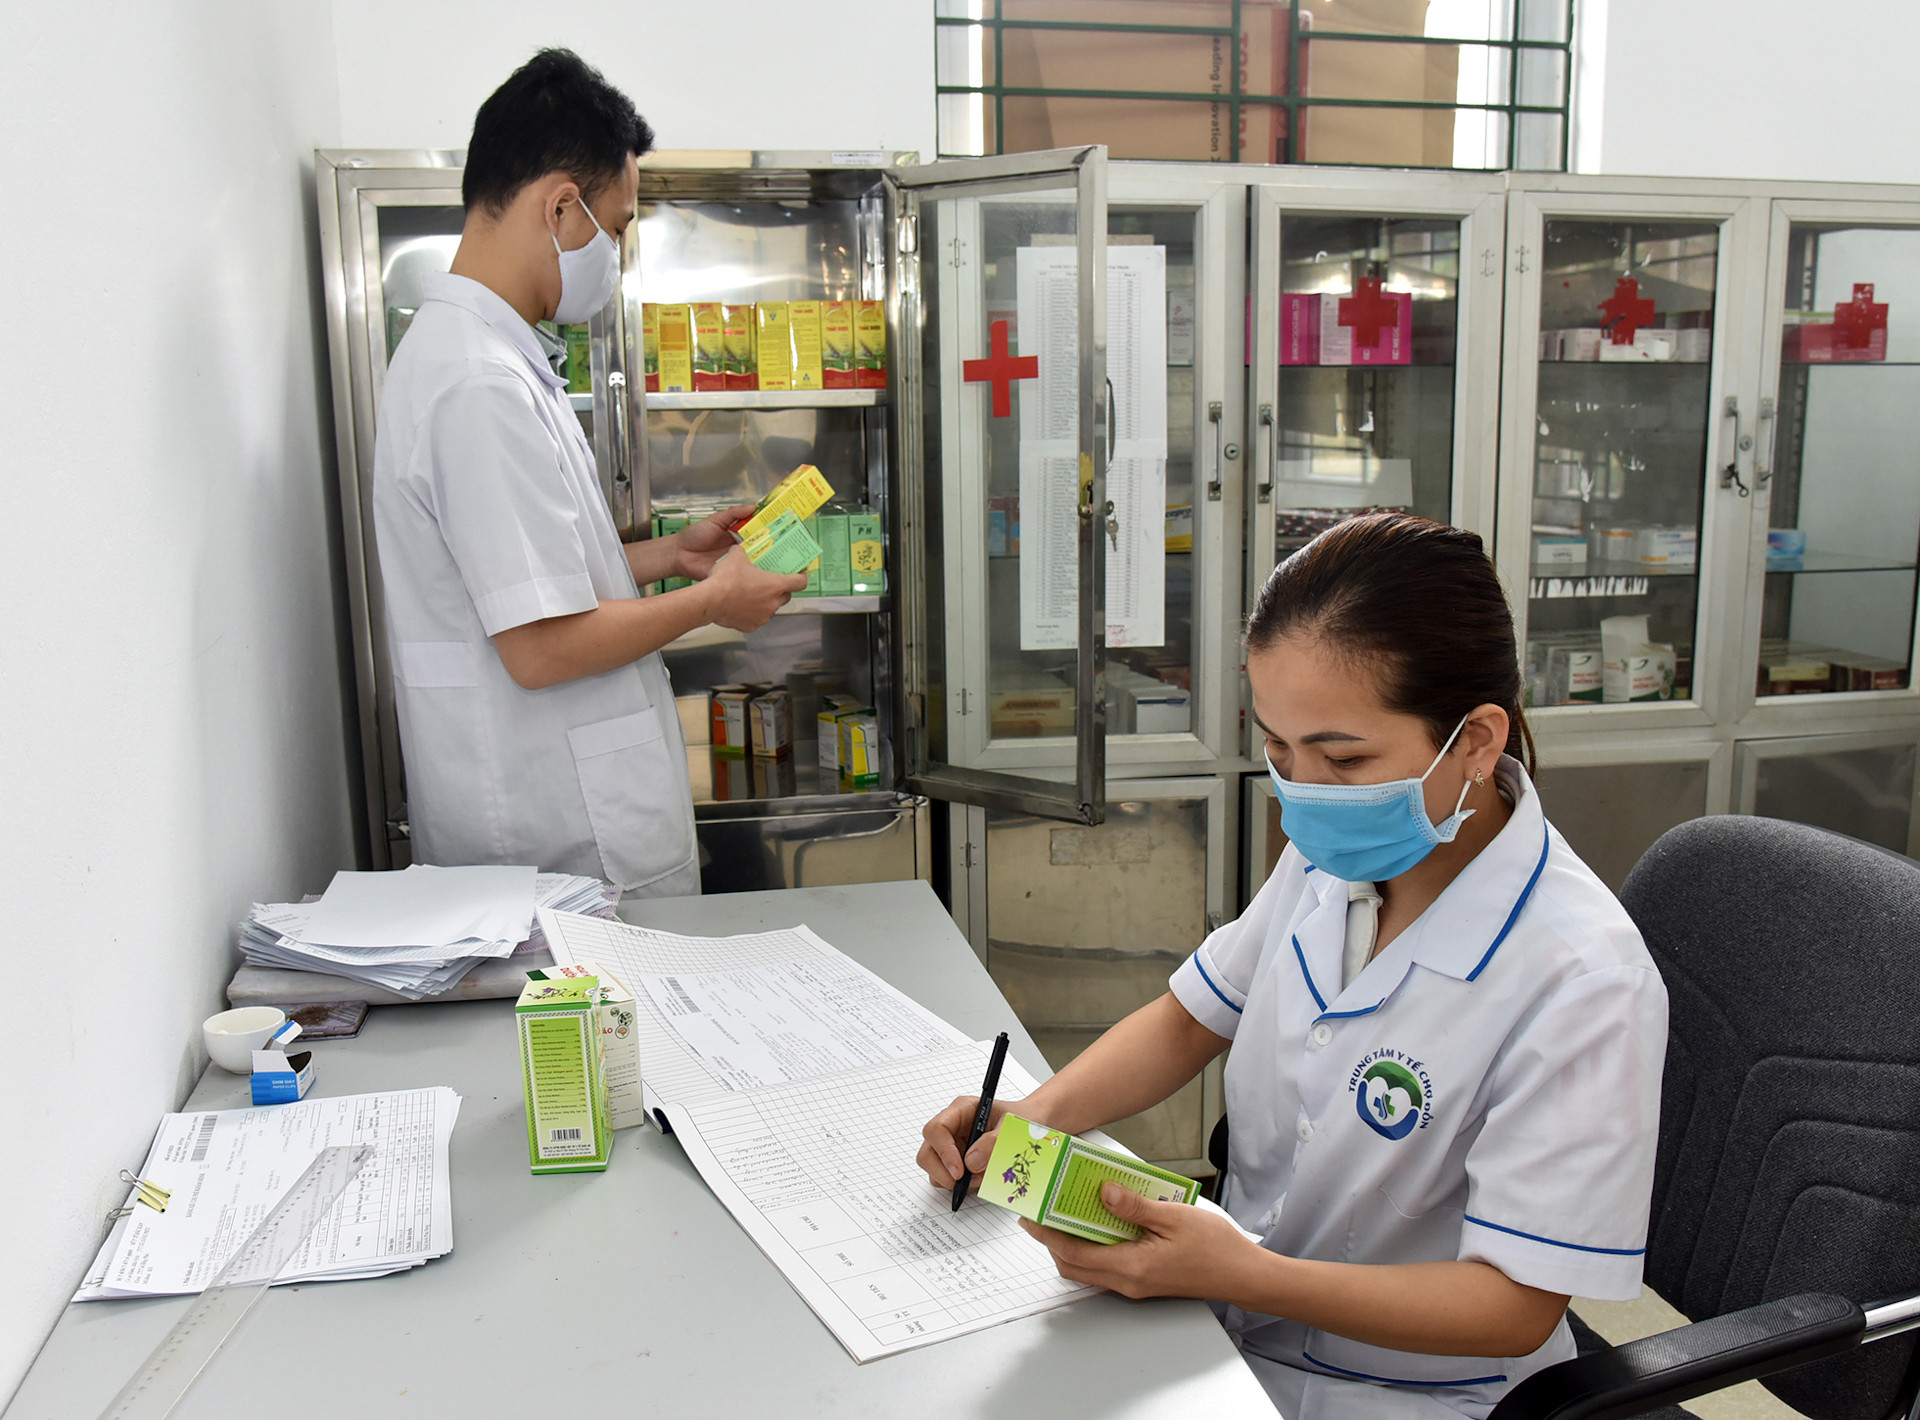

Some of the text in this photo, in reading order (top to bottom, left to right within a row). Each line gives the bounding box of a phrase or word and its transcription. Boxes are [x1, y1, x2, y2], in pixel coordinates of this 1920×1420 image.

[1209, 35, 1223, 81] eading
[1348, 1055, 1372, 1093] TRUNG
[1372, 1047, 1395, 1060] TÂM
[1397, 1051, 1405, 1061] Y
[1406, 1056, 1425, 1072] TẾ
